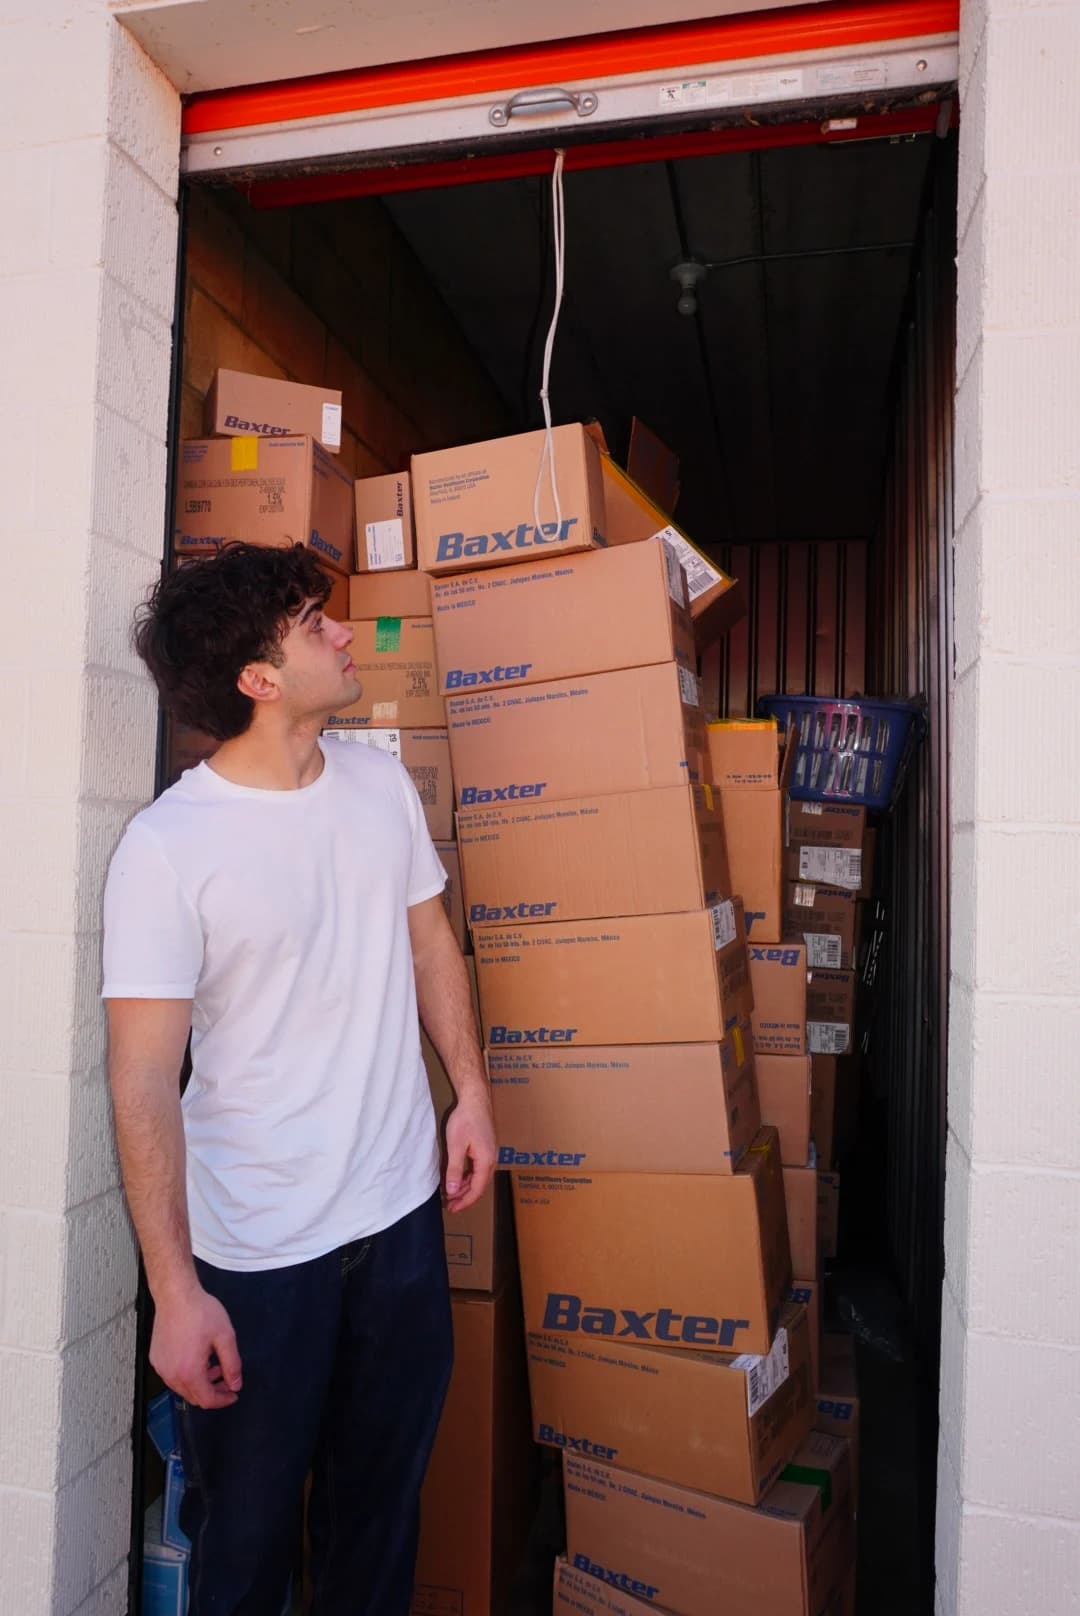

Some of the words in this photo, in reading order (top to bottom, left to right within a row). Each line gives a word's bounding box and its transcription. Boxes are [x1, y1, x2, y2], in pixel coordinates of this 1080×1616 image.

[224, 415, 291, 437] Baxter
[310, 528, 343, 562] Baxter
[436, 518, 578, 562] Baxter
[445, 663, 532, 688] Baxter
[327, 715, 371, 725] Baxter
[460, 782, 547, 805] Baxter
[470, 901, 557, 922] Baxter
[751, 948, 800, 966] Bax
[489, 1025, 578, 1044] Baxter
[497, 1146, 586, 1166] Baxter
[542, 1292, 749, 1346] Baxter
[538, 1423, 619, 1460] Baxter
[573, 1552, 660, 1600] Baxter
